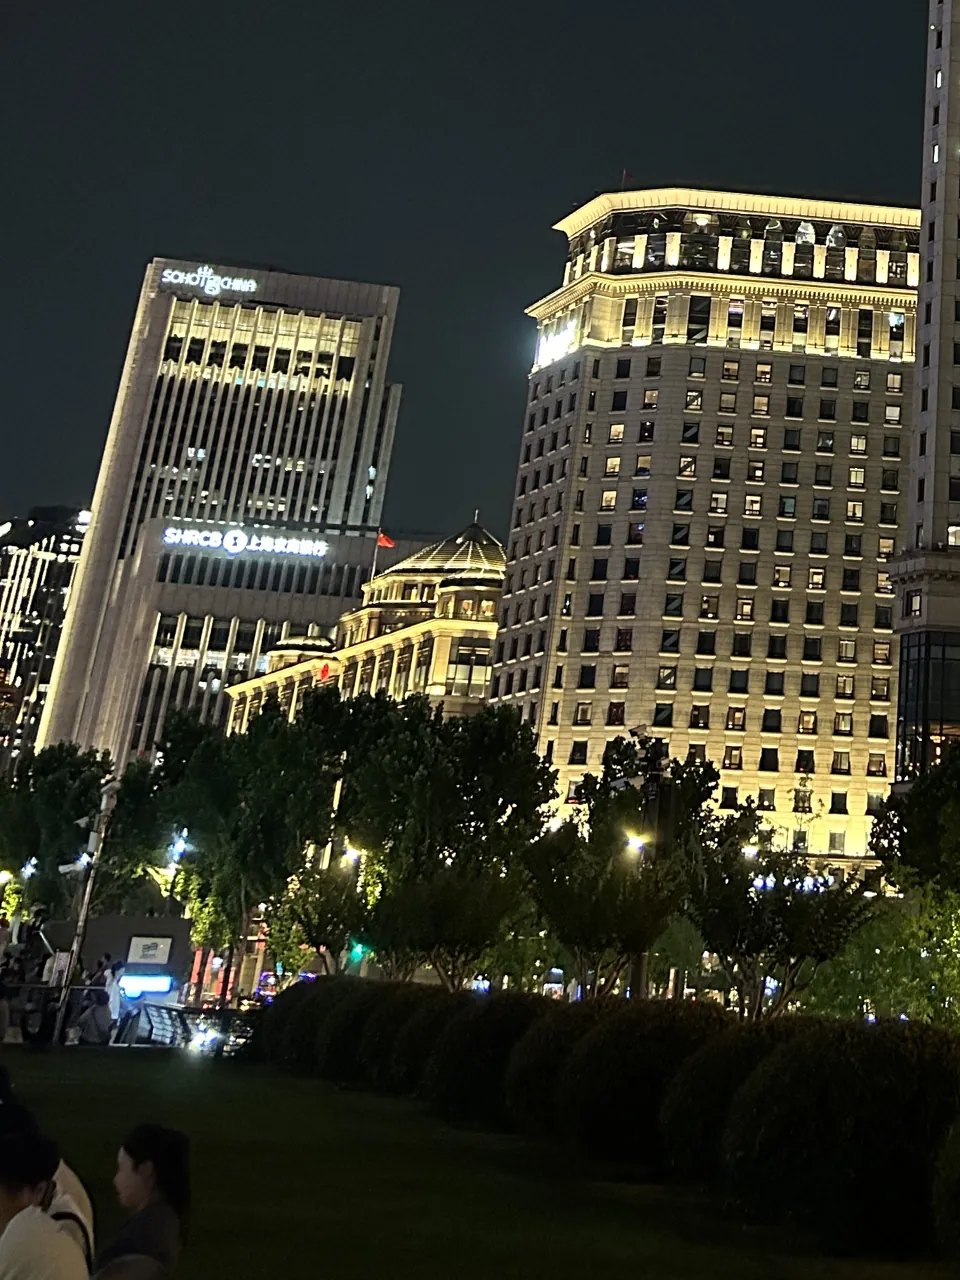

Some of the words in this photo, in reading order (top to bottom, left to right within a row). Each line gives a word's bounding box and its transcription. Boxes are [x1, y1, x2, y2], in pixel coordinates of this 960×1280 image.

[161, 268, 201, 286] SOHO
[220, 276, 258, 293] CHINA
[164, 527, 223, 548] SHRCB
